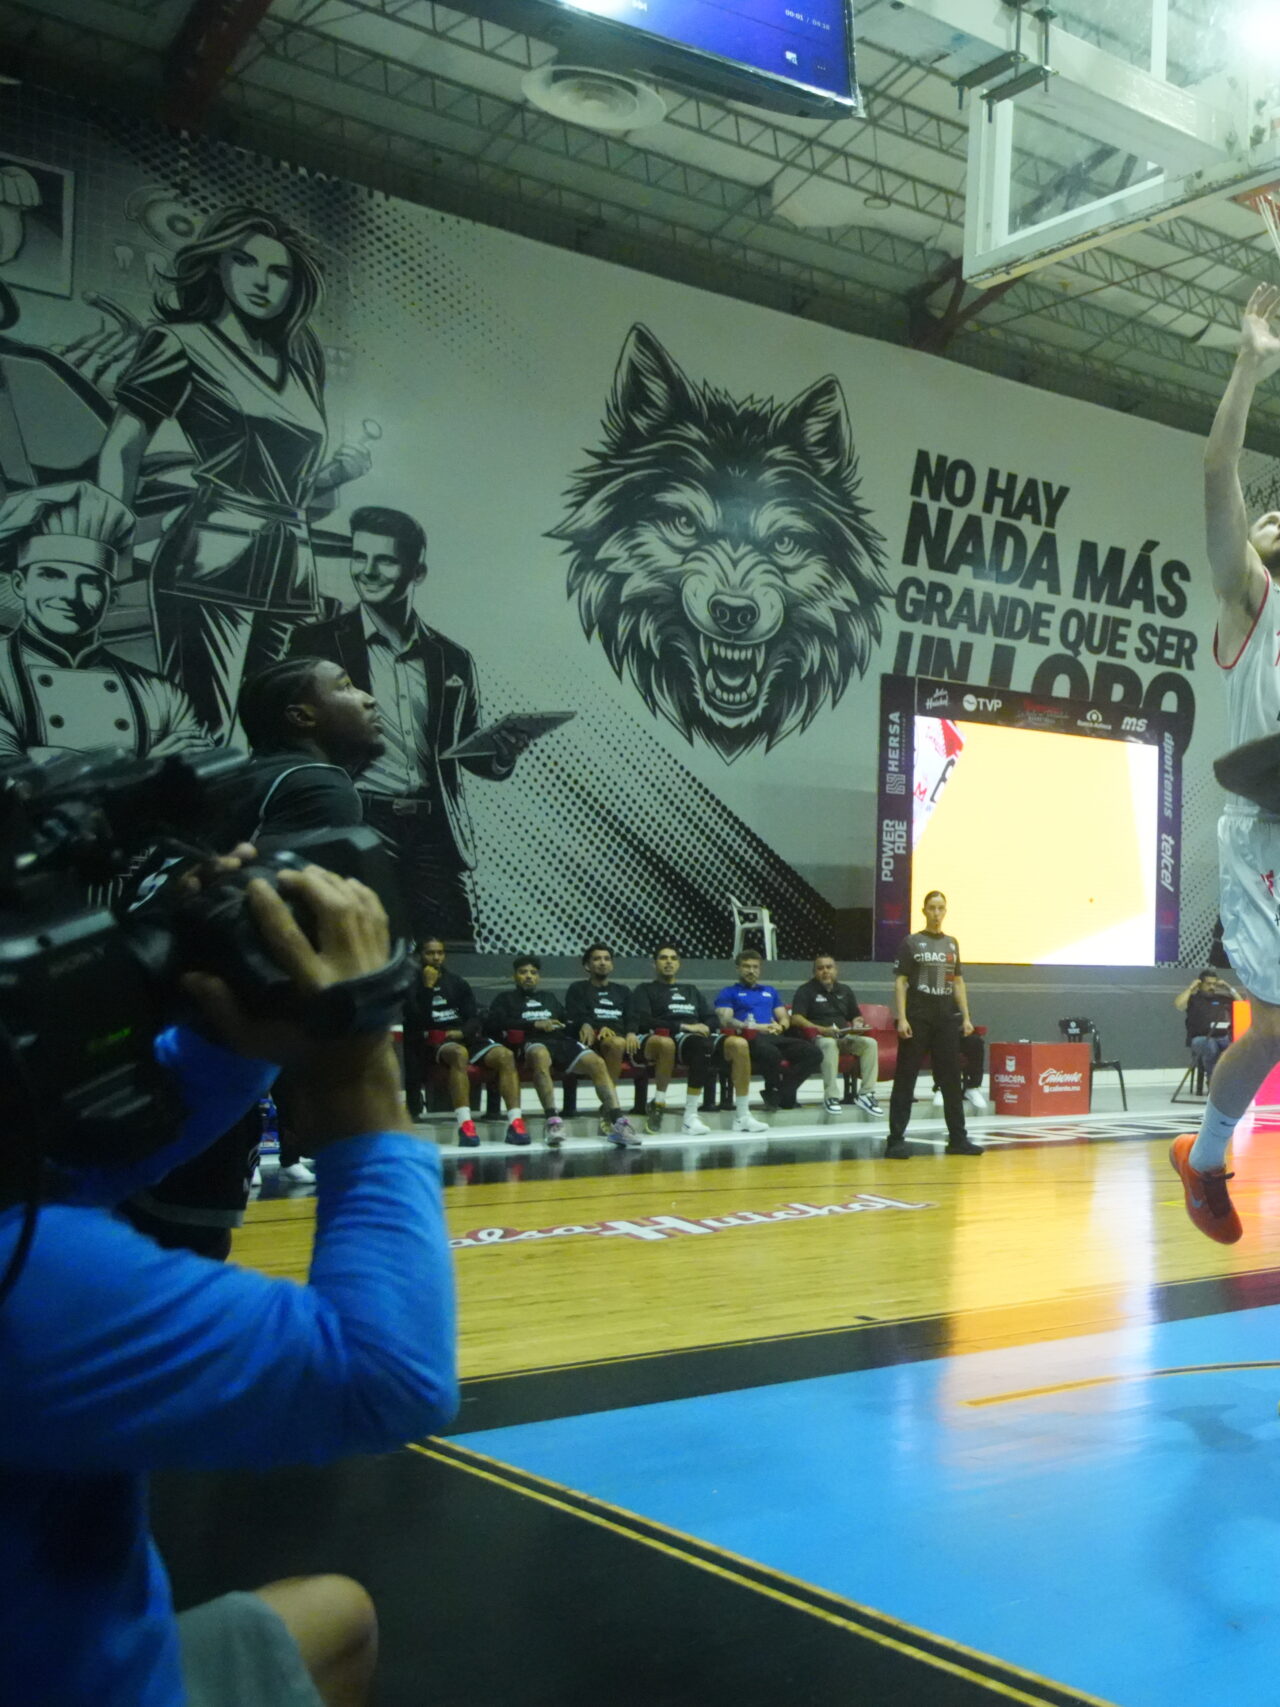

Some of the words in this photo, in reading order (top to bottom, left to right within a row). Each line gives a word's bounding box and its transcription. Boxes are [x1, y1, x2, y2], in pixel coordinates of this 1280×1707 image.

[910, 449, 976, 508] NO
[982, 467, 1070, 529] HAY
[901, 500, 1061, 595] NADA
[1072, 540, 1191, 619] MÁS
[895, 576, 1055, 646] GRANDE
[1059, 608, 1131, 660] QUE
[1134, 623, 1198, 671] SER
[977, 697, 1002, 713] TVP
[888, 711, 900, 772] HERSA
[1162, 731, 1174, 820] dportenis
[881, 818, 895, 882] POWER
[894, 820, 907, 855] ADE
[1161, 832, 1175, 892] telcel
[1038, 1067, 1082, 1086] Caliente
[449, 1228, 601, 1249] alsa
[600, 1194, 925, 1241] Huichol
